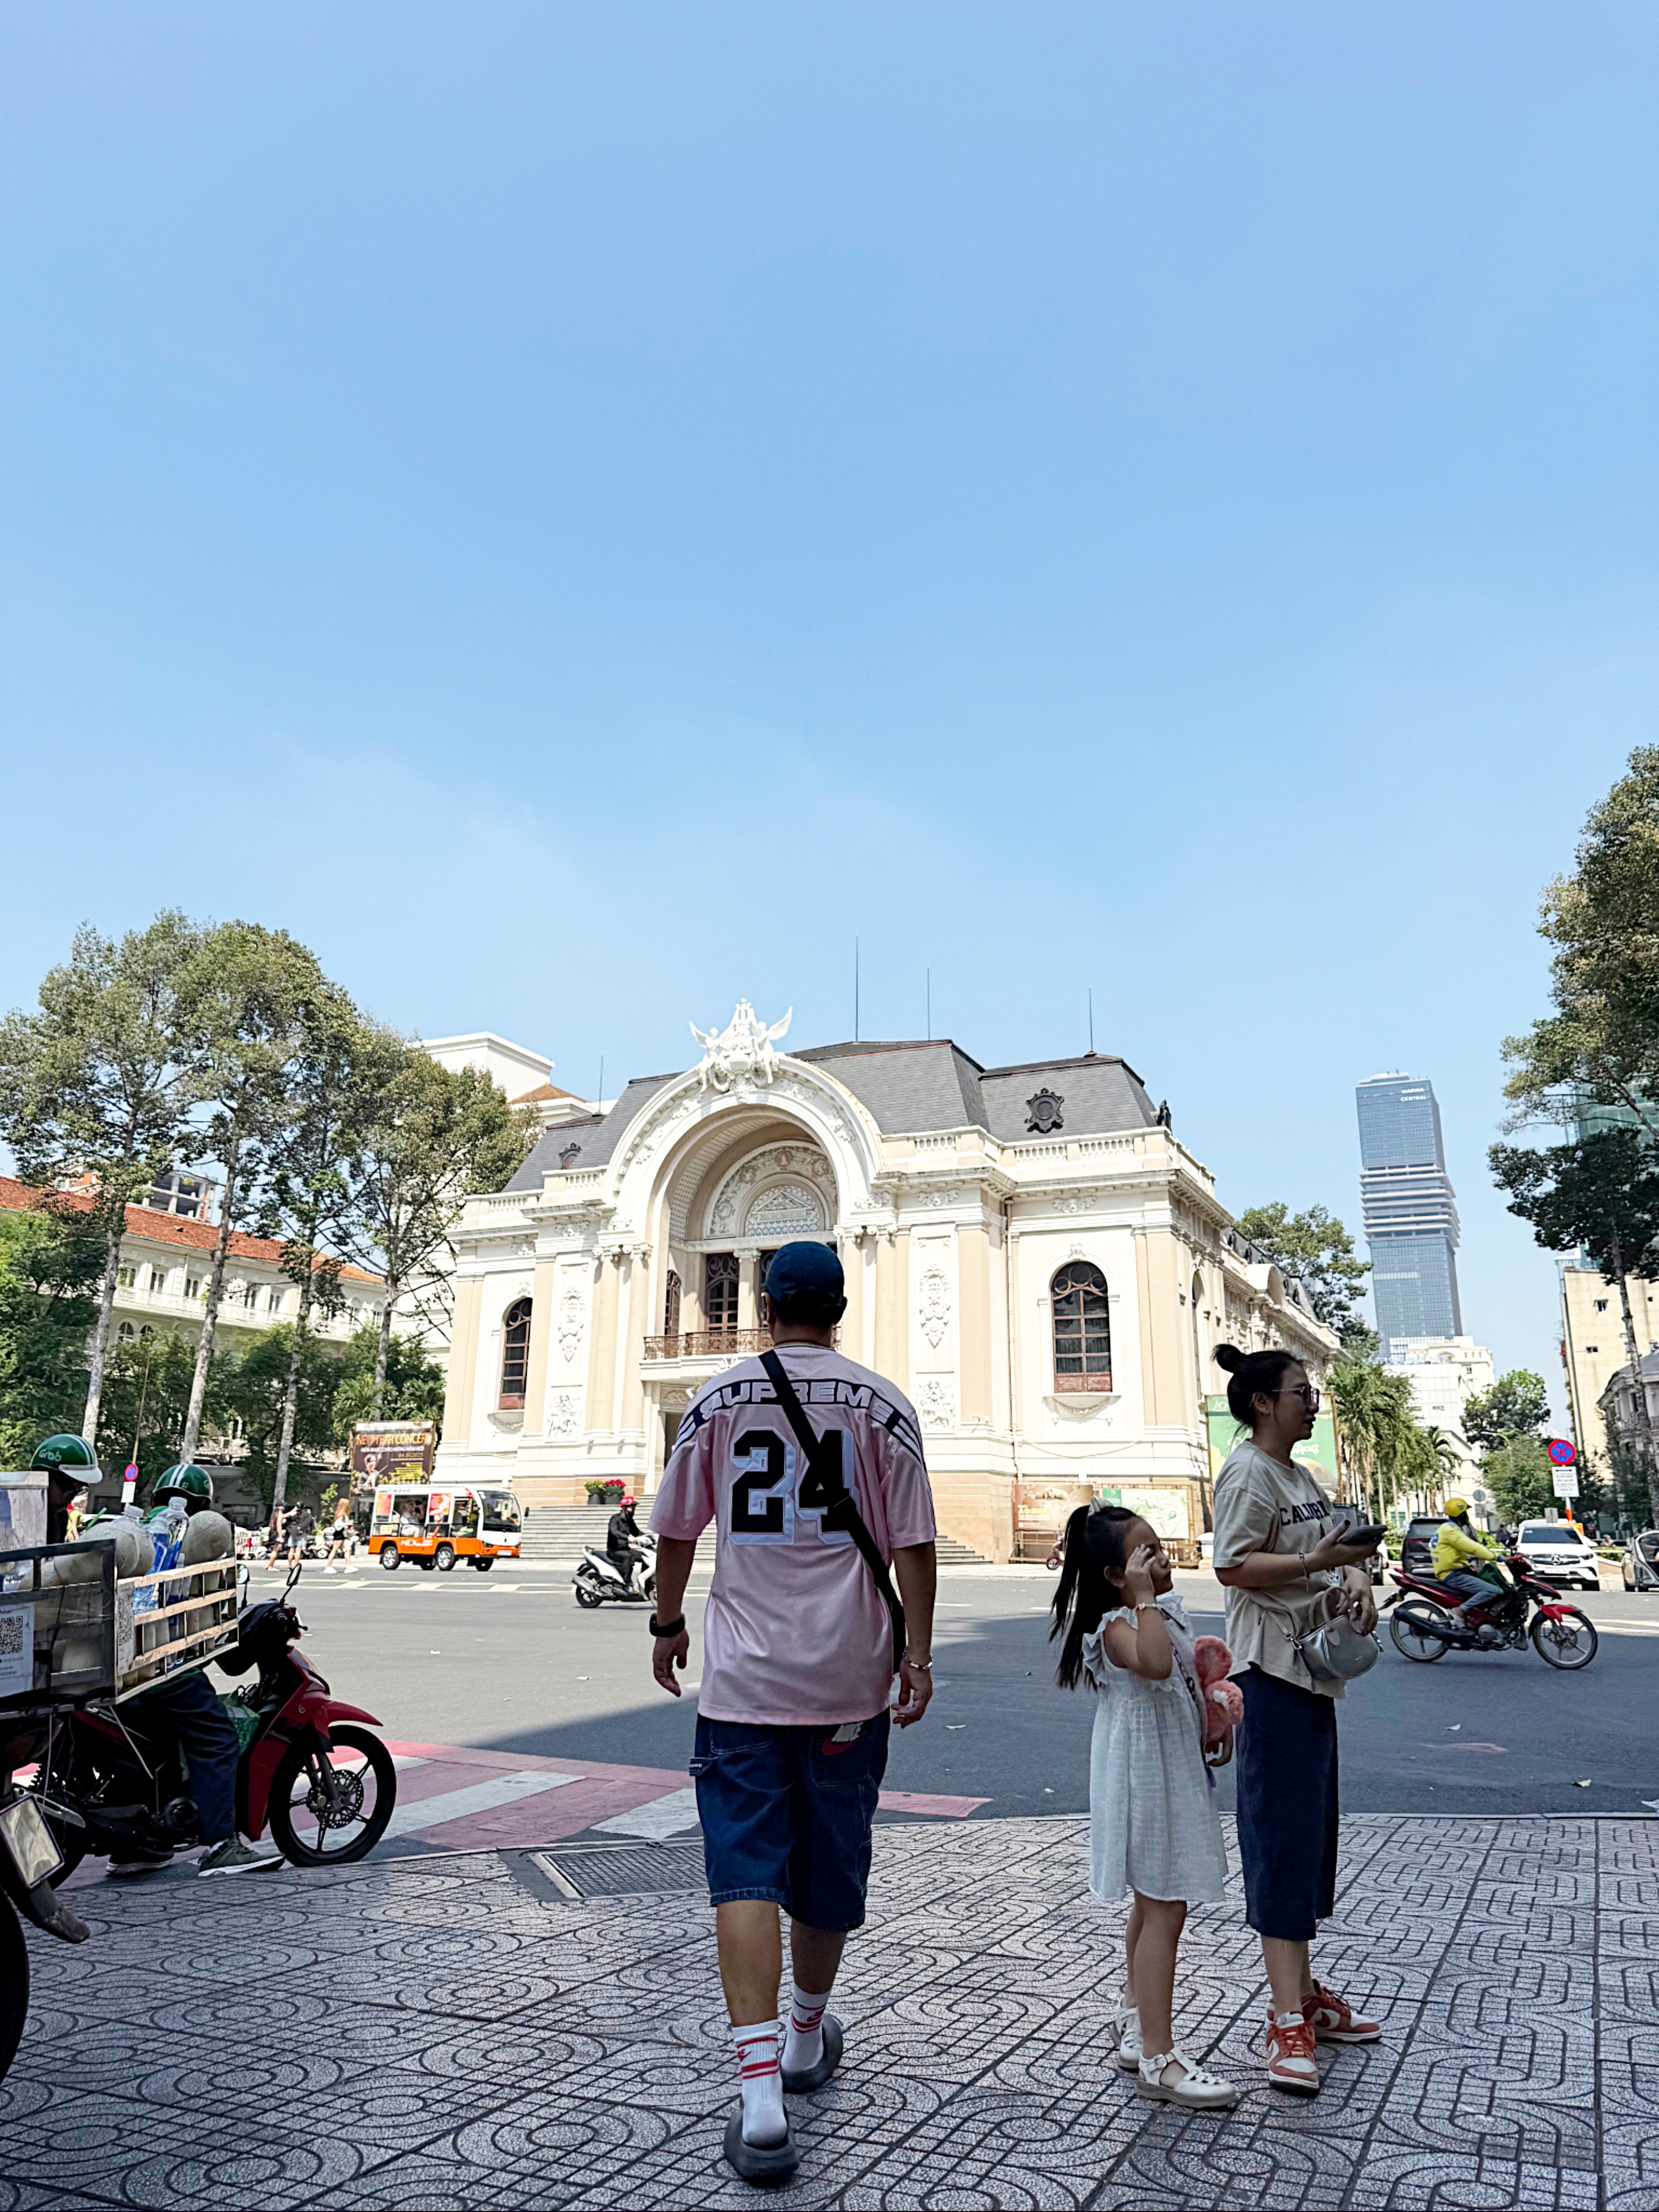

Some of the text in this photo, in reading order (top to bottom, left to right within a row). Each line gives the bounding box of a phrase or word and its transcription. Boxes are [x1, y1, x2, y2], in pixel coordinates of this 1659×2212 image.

[356, 1432, 430, 1445] NEW YEAR CONCER
[38, 1449, 62, 1462] Grab
[729, 1426, 861, 1545] 24
